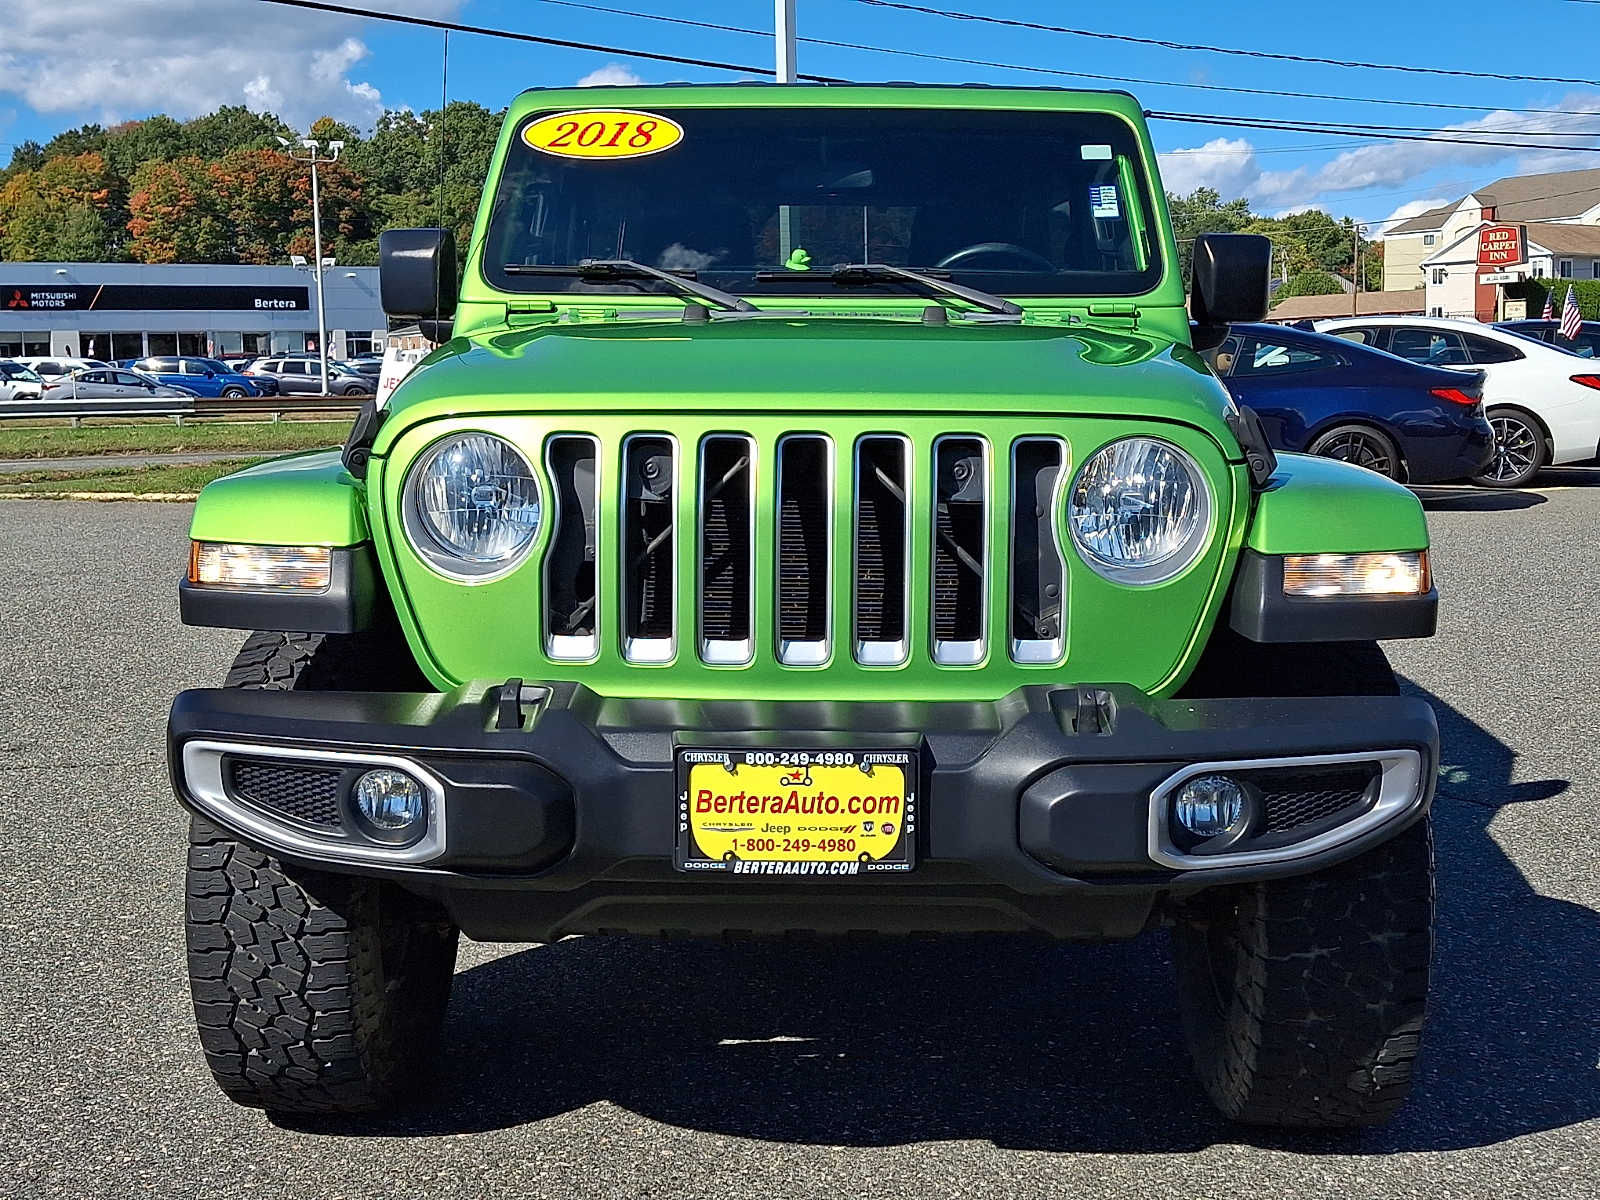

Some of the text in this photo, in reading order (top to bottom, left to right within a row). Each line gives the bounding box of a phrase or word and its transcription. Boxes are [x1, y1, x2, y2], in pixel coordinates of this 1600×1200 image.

[547, 120, 658, 148] 2018
[1488, 231, 1509, 240] RED
[1481, 241, 1516, 251] CARPET
[1489, 251, 1508, 260] INN
[30, 292, 77, 300] MITSUBISHI
[254, 298, 297, 309] Bertera
[383, 377, 401, 390] JE
[684, 752, 730, 763] CHRYSLER
[745, 752, 854, 765] 800-249-4980
[863, 753, 909, 764] CHRYSLER
[695, 789, 900, 815] BerteraAuto.com
[679, 791, 688, 833] Jeep
[906, 792, 915, 834] Jeep
[761, 822, 791, 835] Jeep
[732, 838, 856, 852] 1-800-249-4980
[733, 861, 860, 875] BERTERAAUTO.COM
